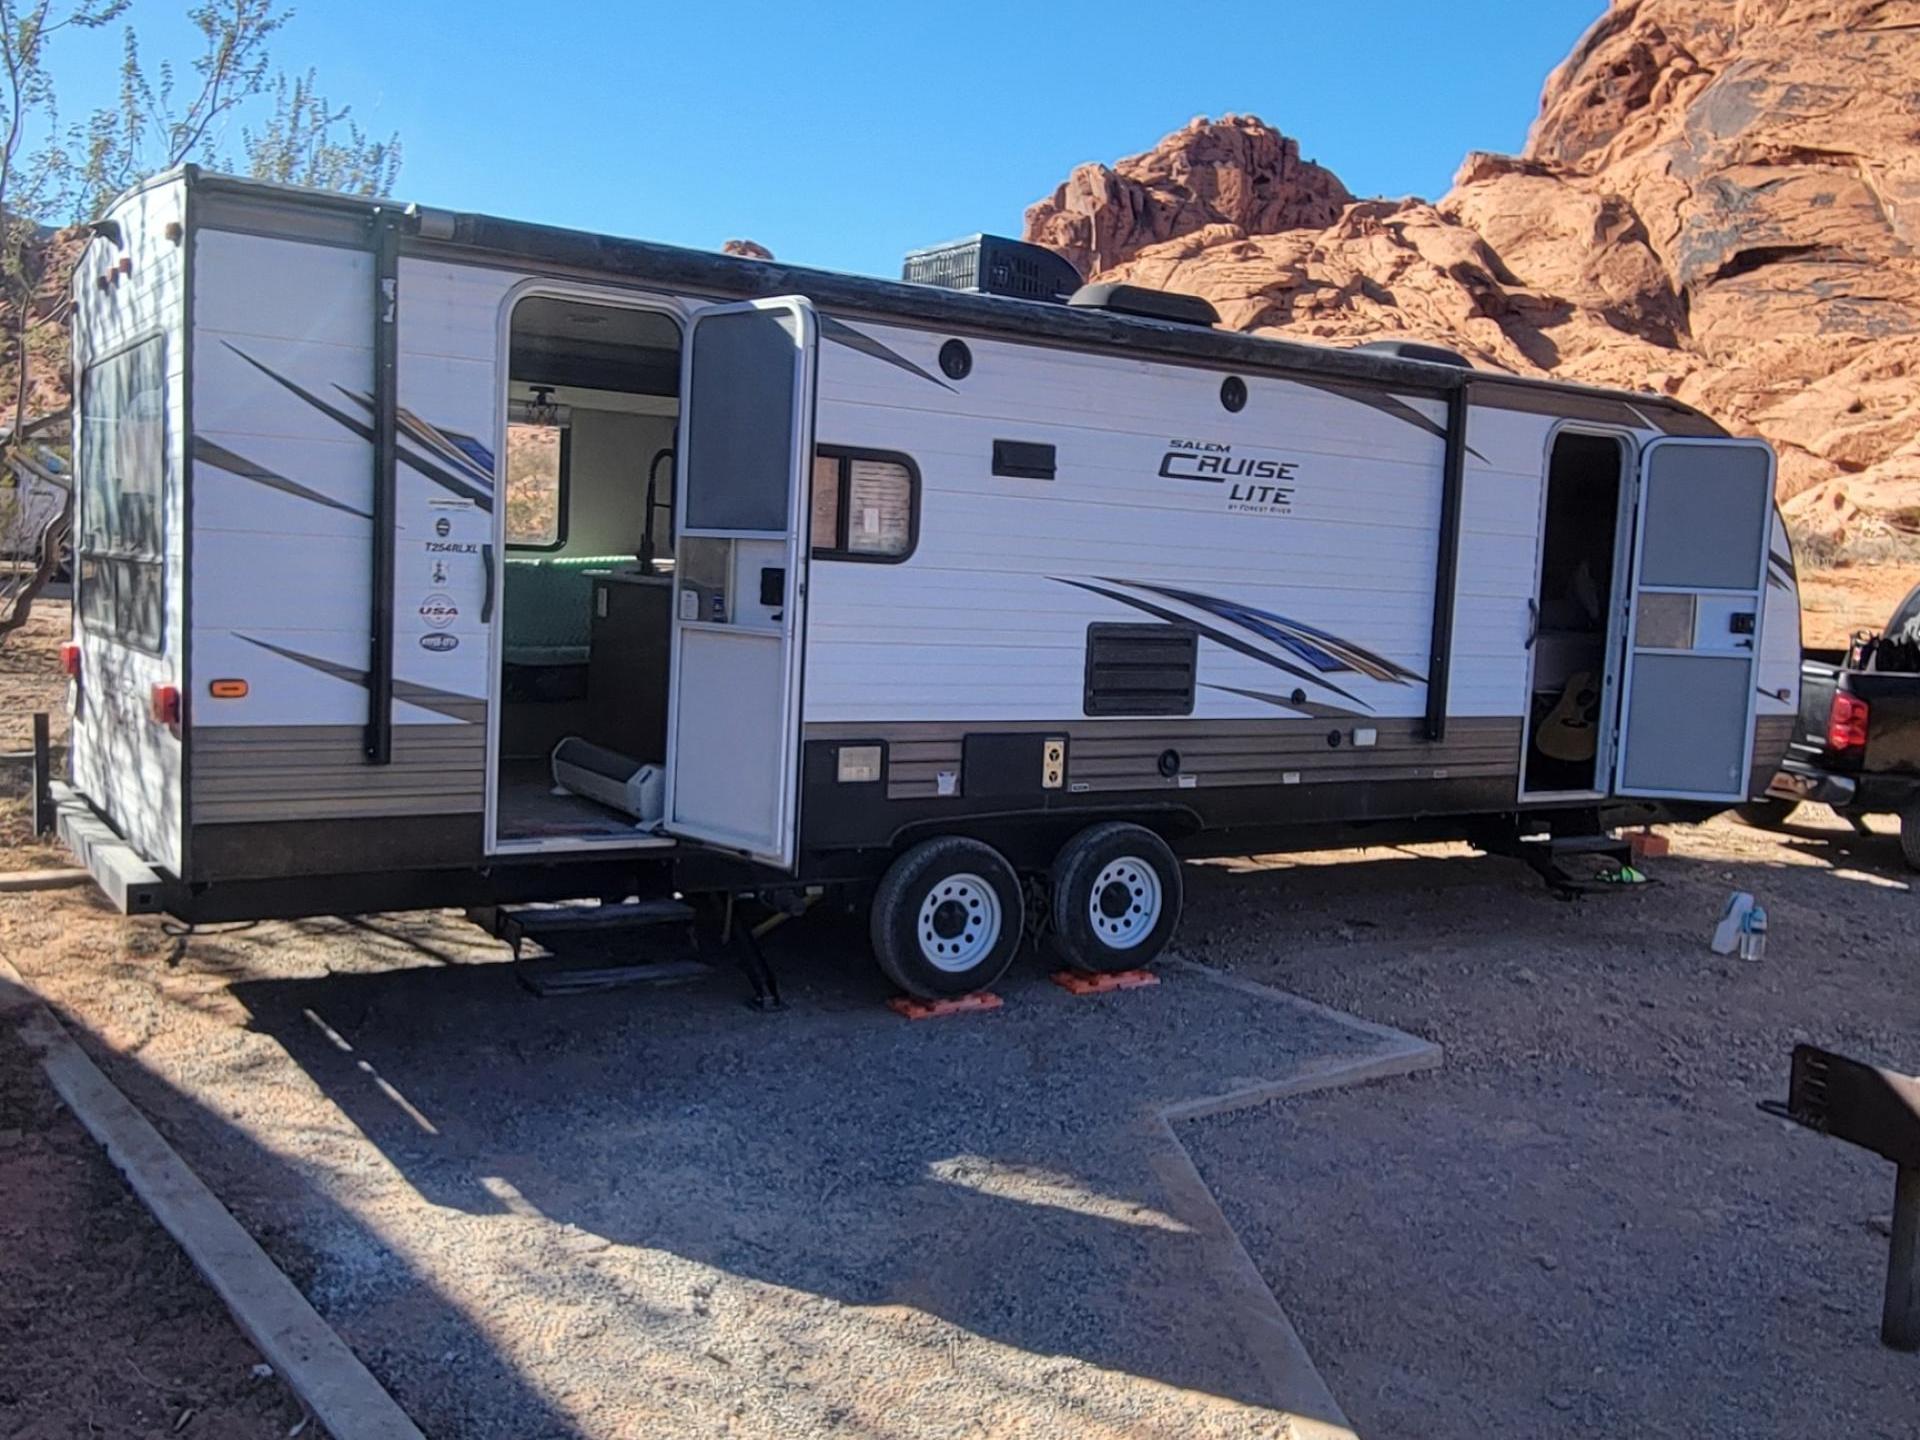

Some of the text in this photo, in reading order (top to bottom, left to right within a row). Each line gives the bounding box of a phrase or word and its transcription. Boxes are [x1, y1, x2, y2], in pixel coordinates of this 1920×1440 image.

[1168, 440, 1231, 453] SALEM
[1158, 452, 1299, 483] CRUISE
[1230, 484, 1295, 505] LITE
[419, 607, 459, 616] USA
